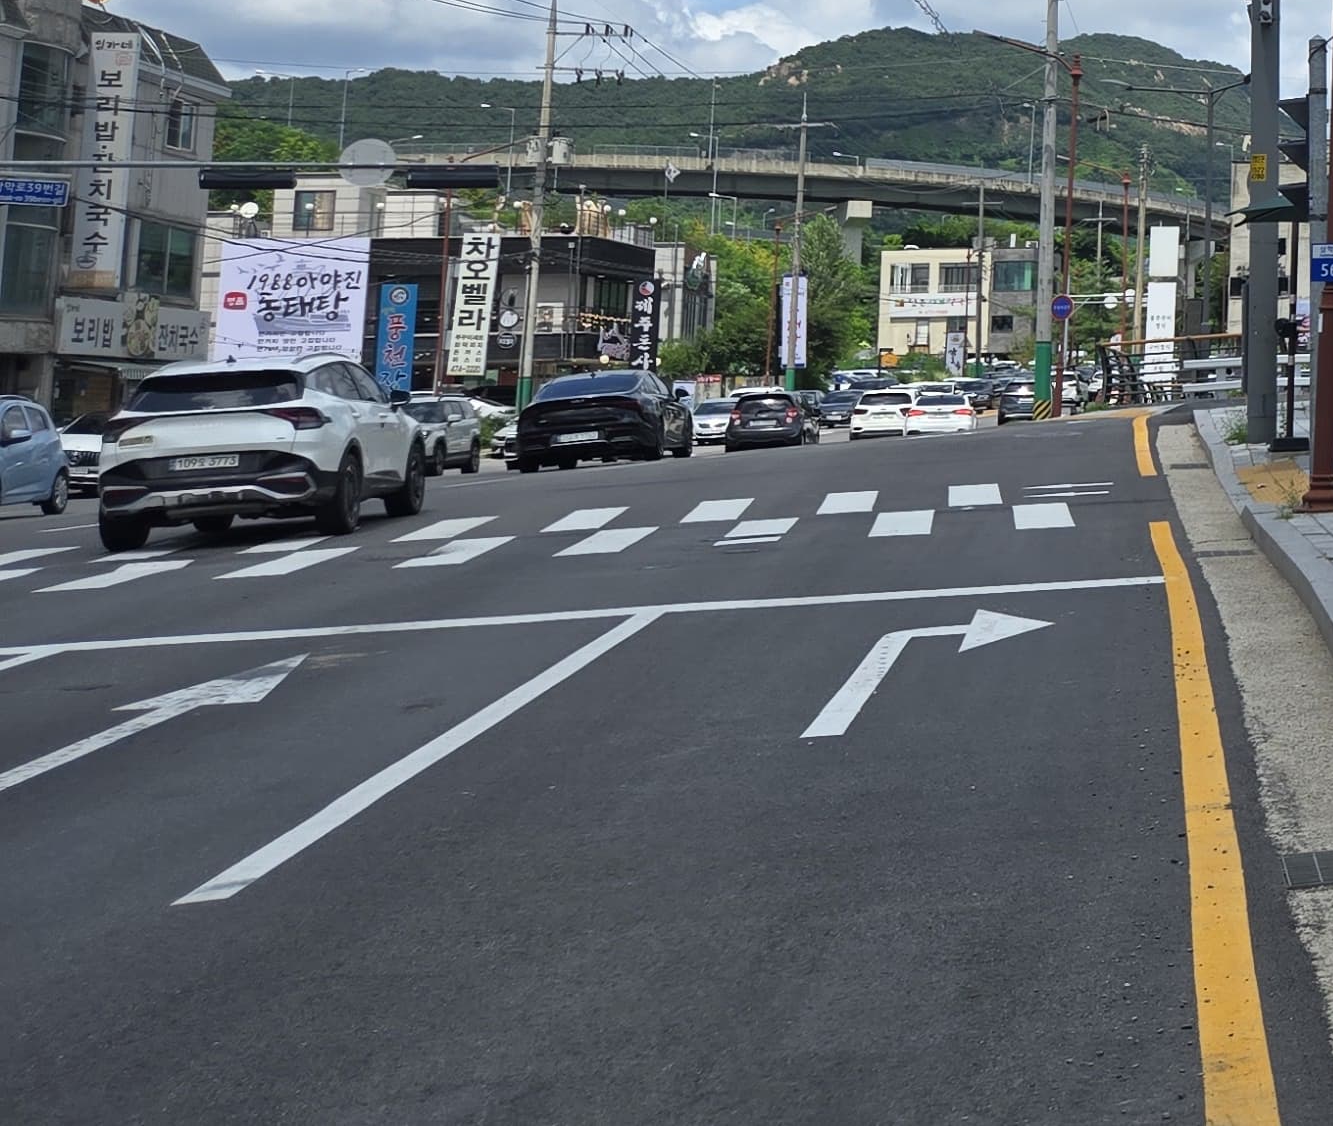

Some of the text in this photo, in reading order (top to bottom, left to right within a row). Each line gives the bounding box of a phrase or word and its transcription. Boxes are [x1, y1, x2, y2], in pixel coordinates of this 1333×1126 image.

[247, 269, 362, 291] 1988아야진
[457, 236, 497, 331] 차오벨라
[257, 290, 349, 322] 동태탕
[71, 317, 114, 349] 보리밥
[158, 324, 199, 355] 잔치국수
[631, 296, 654, 370] 제주돈사
